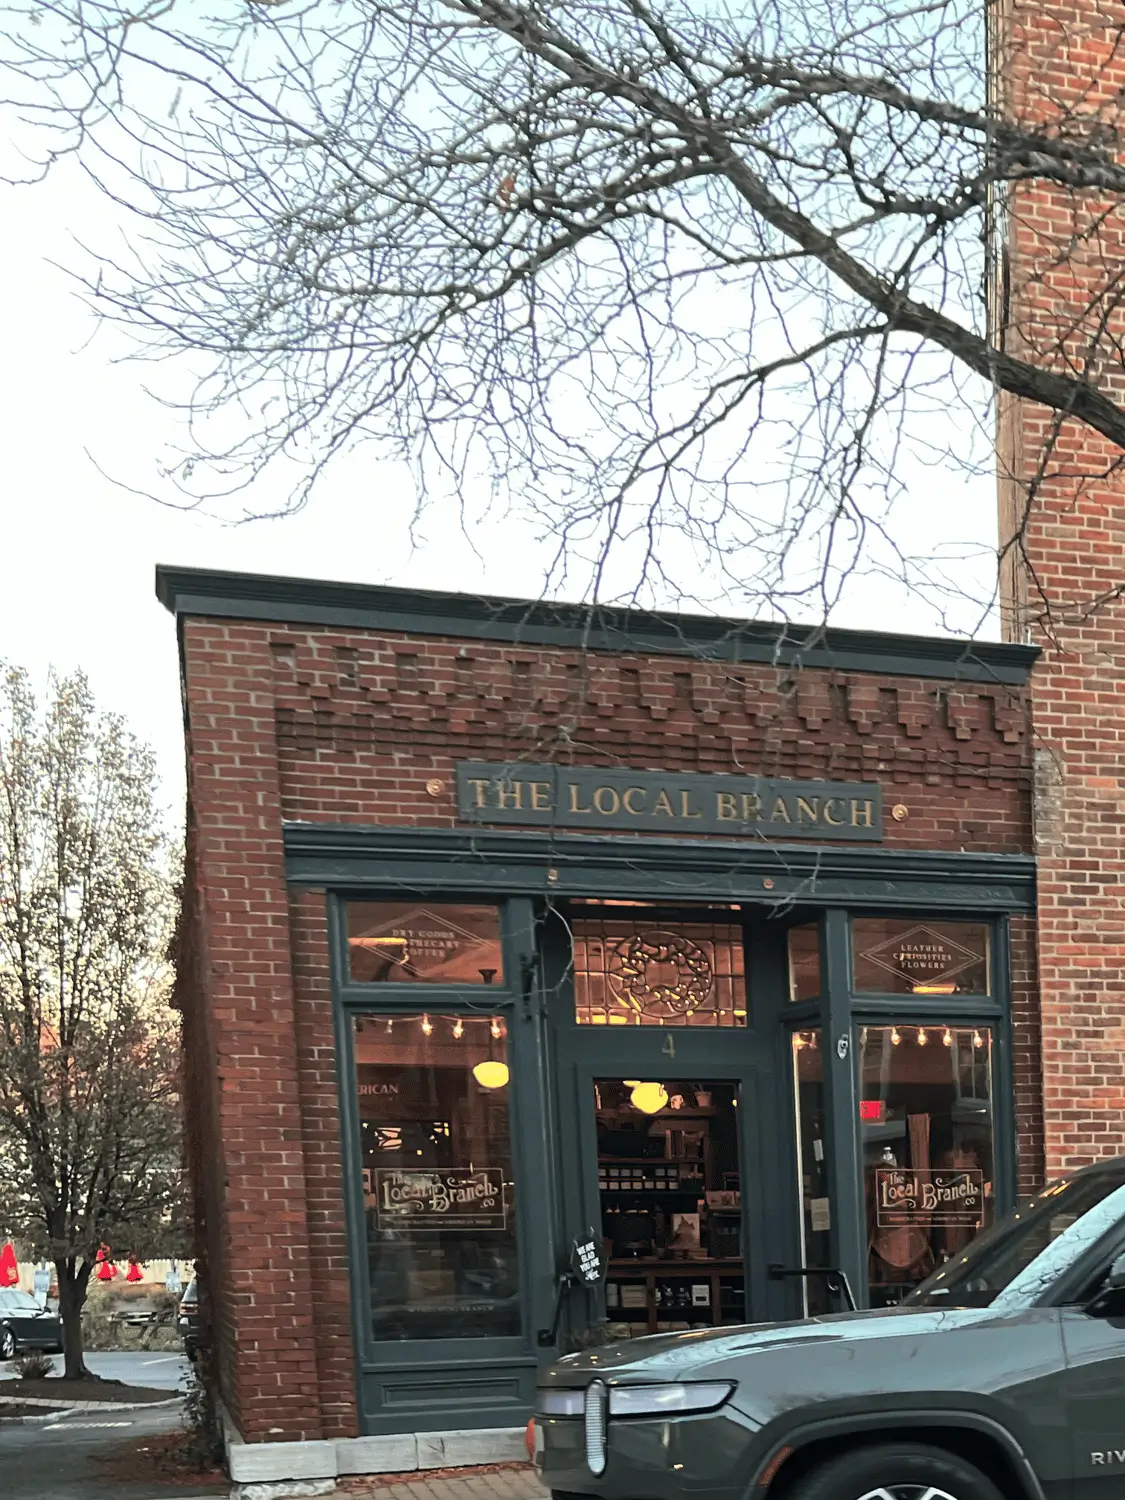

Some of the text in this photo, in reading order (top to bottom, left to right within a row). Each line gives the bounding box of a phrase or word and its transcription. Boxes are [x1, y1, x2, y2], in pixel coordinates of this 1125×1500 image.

[467, 778, 876, 828] THE LOCAL BRANCH
[392, 929, 455, 939] DRY GOODS
[407, 948, 446, 958] OFFEE
[901, 944, 944, 953] LEATHER
[901, 961, 945, 969] FLOWERS
[661, 1032, 676, 1059] 4
[888, 1171, 905, 1185] The
[430, 1172, 499, 1212] Branch
[881, 1173, 979, 1210] Local Branch
[580, 1250, 596, 1263] GLAD
[579, 1261, 591, 1272] YOU
